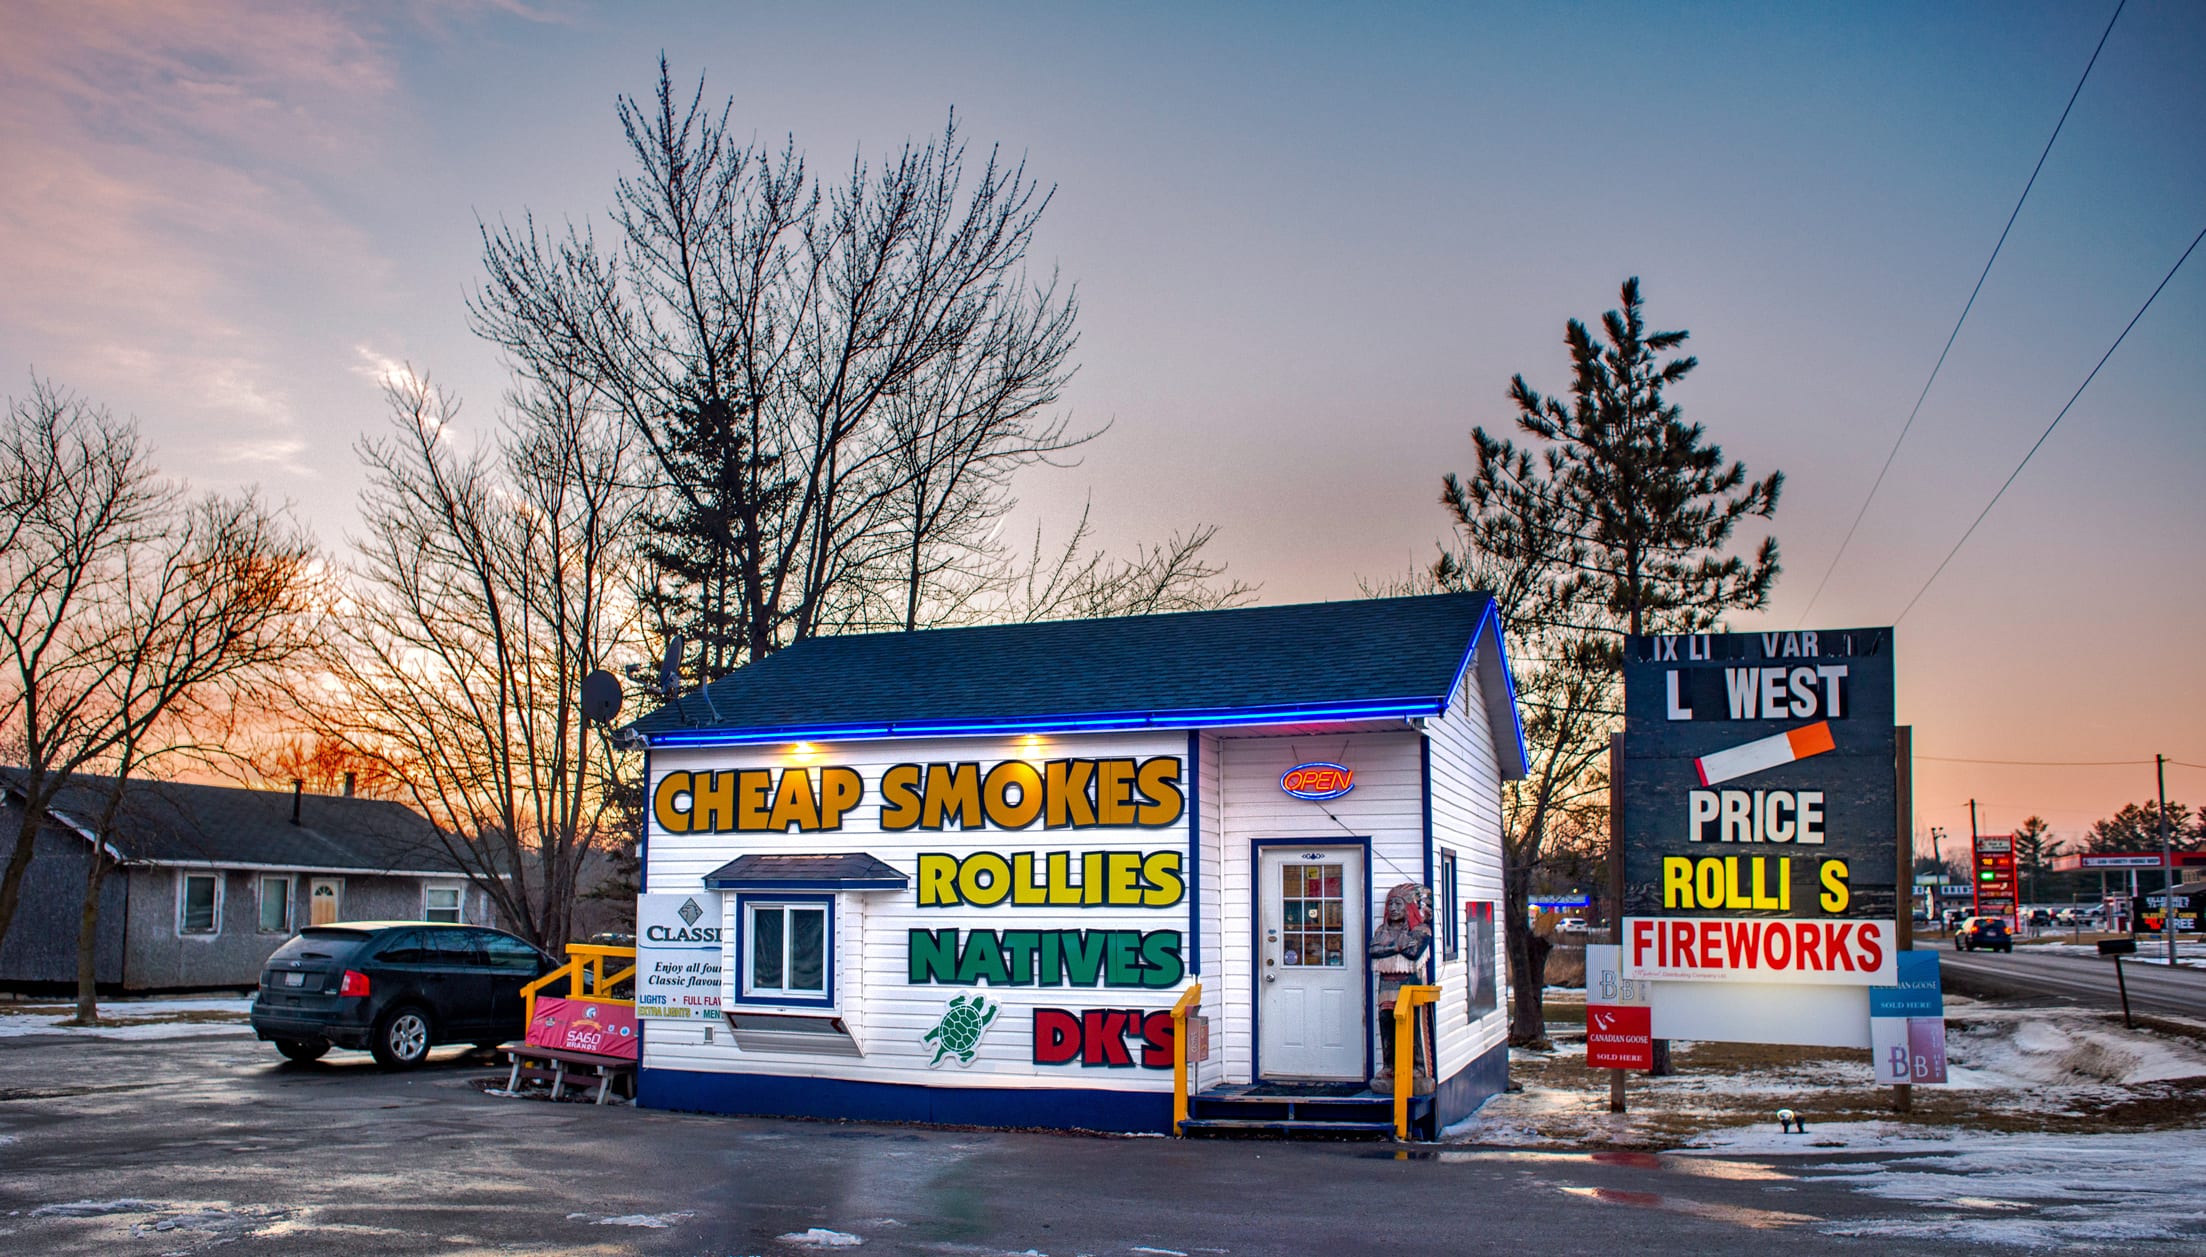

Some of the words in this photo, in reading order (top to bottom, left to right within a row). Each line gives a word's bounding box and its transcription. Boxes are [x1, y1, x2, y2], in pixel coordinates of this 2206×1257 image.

[1761, 632, 1819, 658] VAR
[1725, 664, 1848, 719] WEST
[1284, 770, 1353, 790] OPEN
[653, 766, 864, 834] CHEAP
[880, 756, 1185, 831] SMOKES
[1688, 790, 1825, 844] PRICE
[917, 850, 1186, 908] ROLLIES
[908, 927, 1185, 988] NATIVES
[1633, 920, 1883, 973] FIREWORKS
[654, 962, 683, 974] Enjoy
[686, 963, 700, 973] all
[648, 975, 685, 986] Classic
[1912, 981, 1937, 990] GOOSE
[639, 995, 667, 1005] LIGHTS
[683, 996, 702, 1005] FULL
[637, 1006, 662, 1017] EXTRA
[663, 1007, 691, 1018] LIGHTS
[1032, 1007, 1175, 1069] DK'S
[1590, 1033, 1625, 1043] CANADIAN
[1625, 1035, 1648, 1044] GOOSE
[1597, 1053, 1618, 1061] SOLD
[1620, 1054, 1643, 1062] HERE
